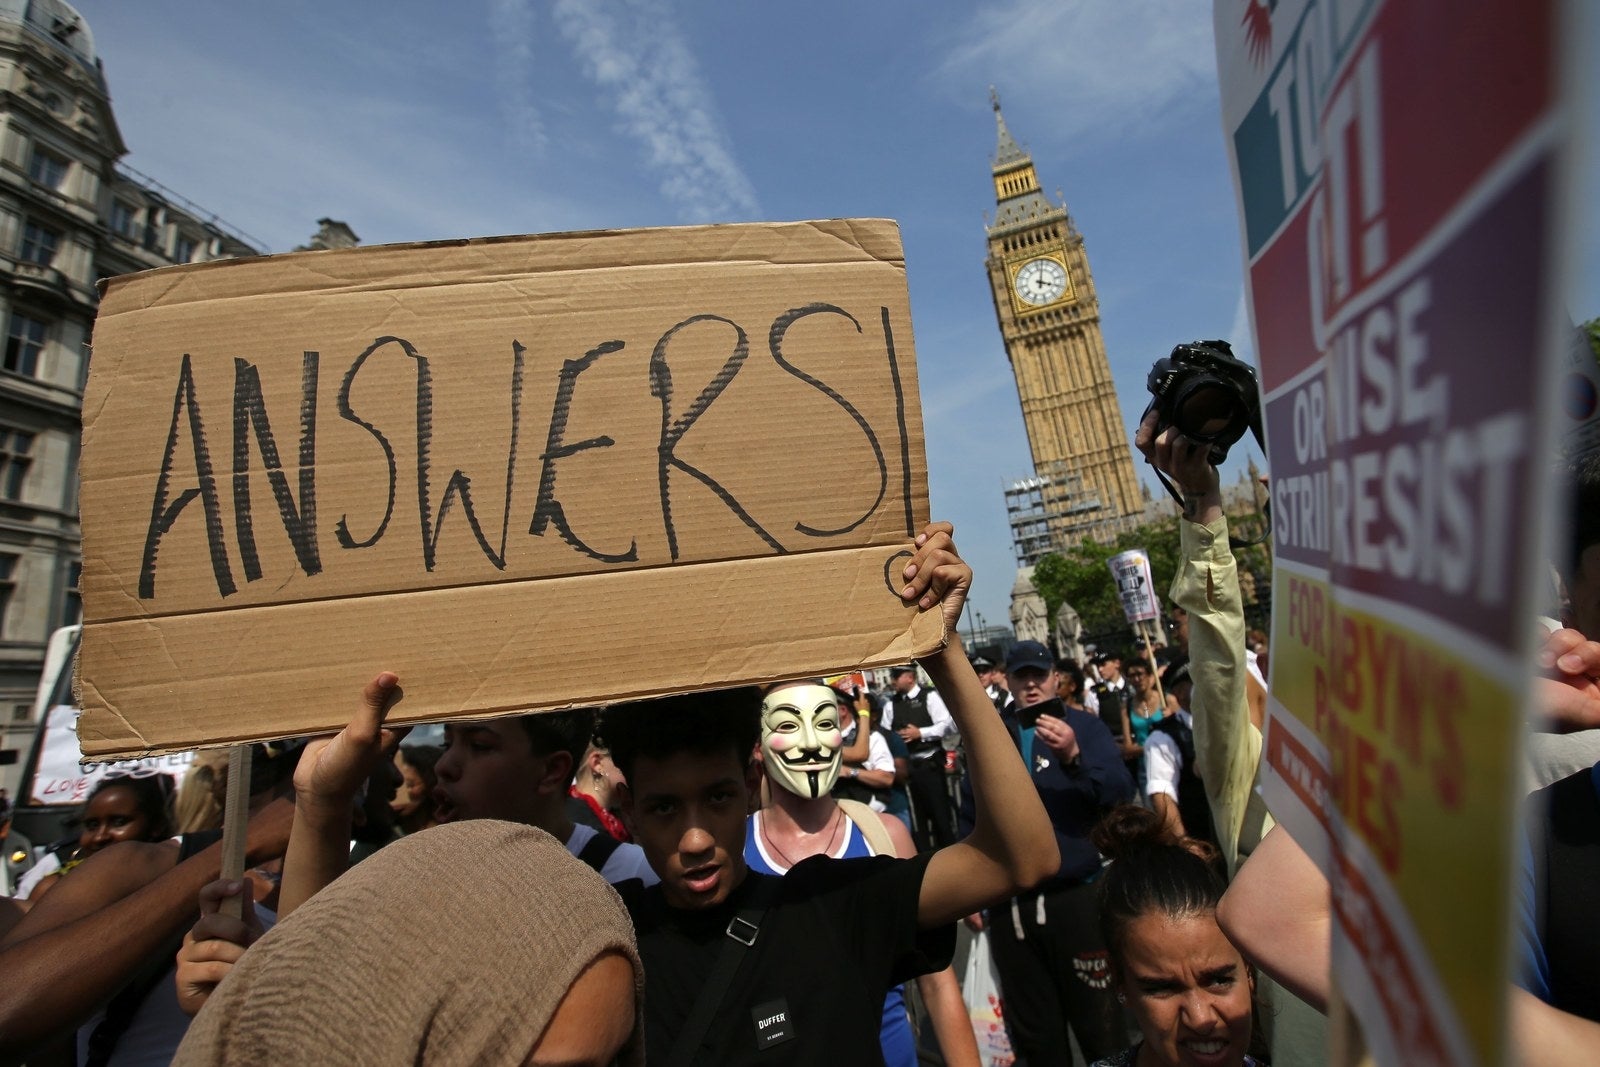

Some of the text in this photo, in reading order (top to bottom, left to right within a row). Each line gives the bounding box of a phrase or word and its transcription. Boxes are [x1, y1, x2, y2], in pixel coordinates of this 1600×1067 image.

[1331, 408, 1527, 607] RESIST
[1289, 577, 1325, 658] FOR
[43, 777, 89, 795] LOVE
[758, 1013, 786, 1030] DUFFER
